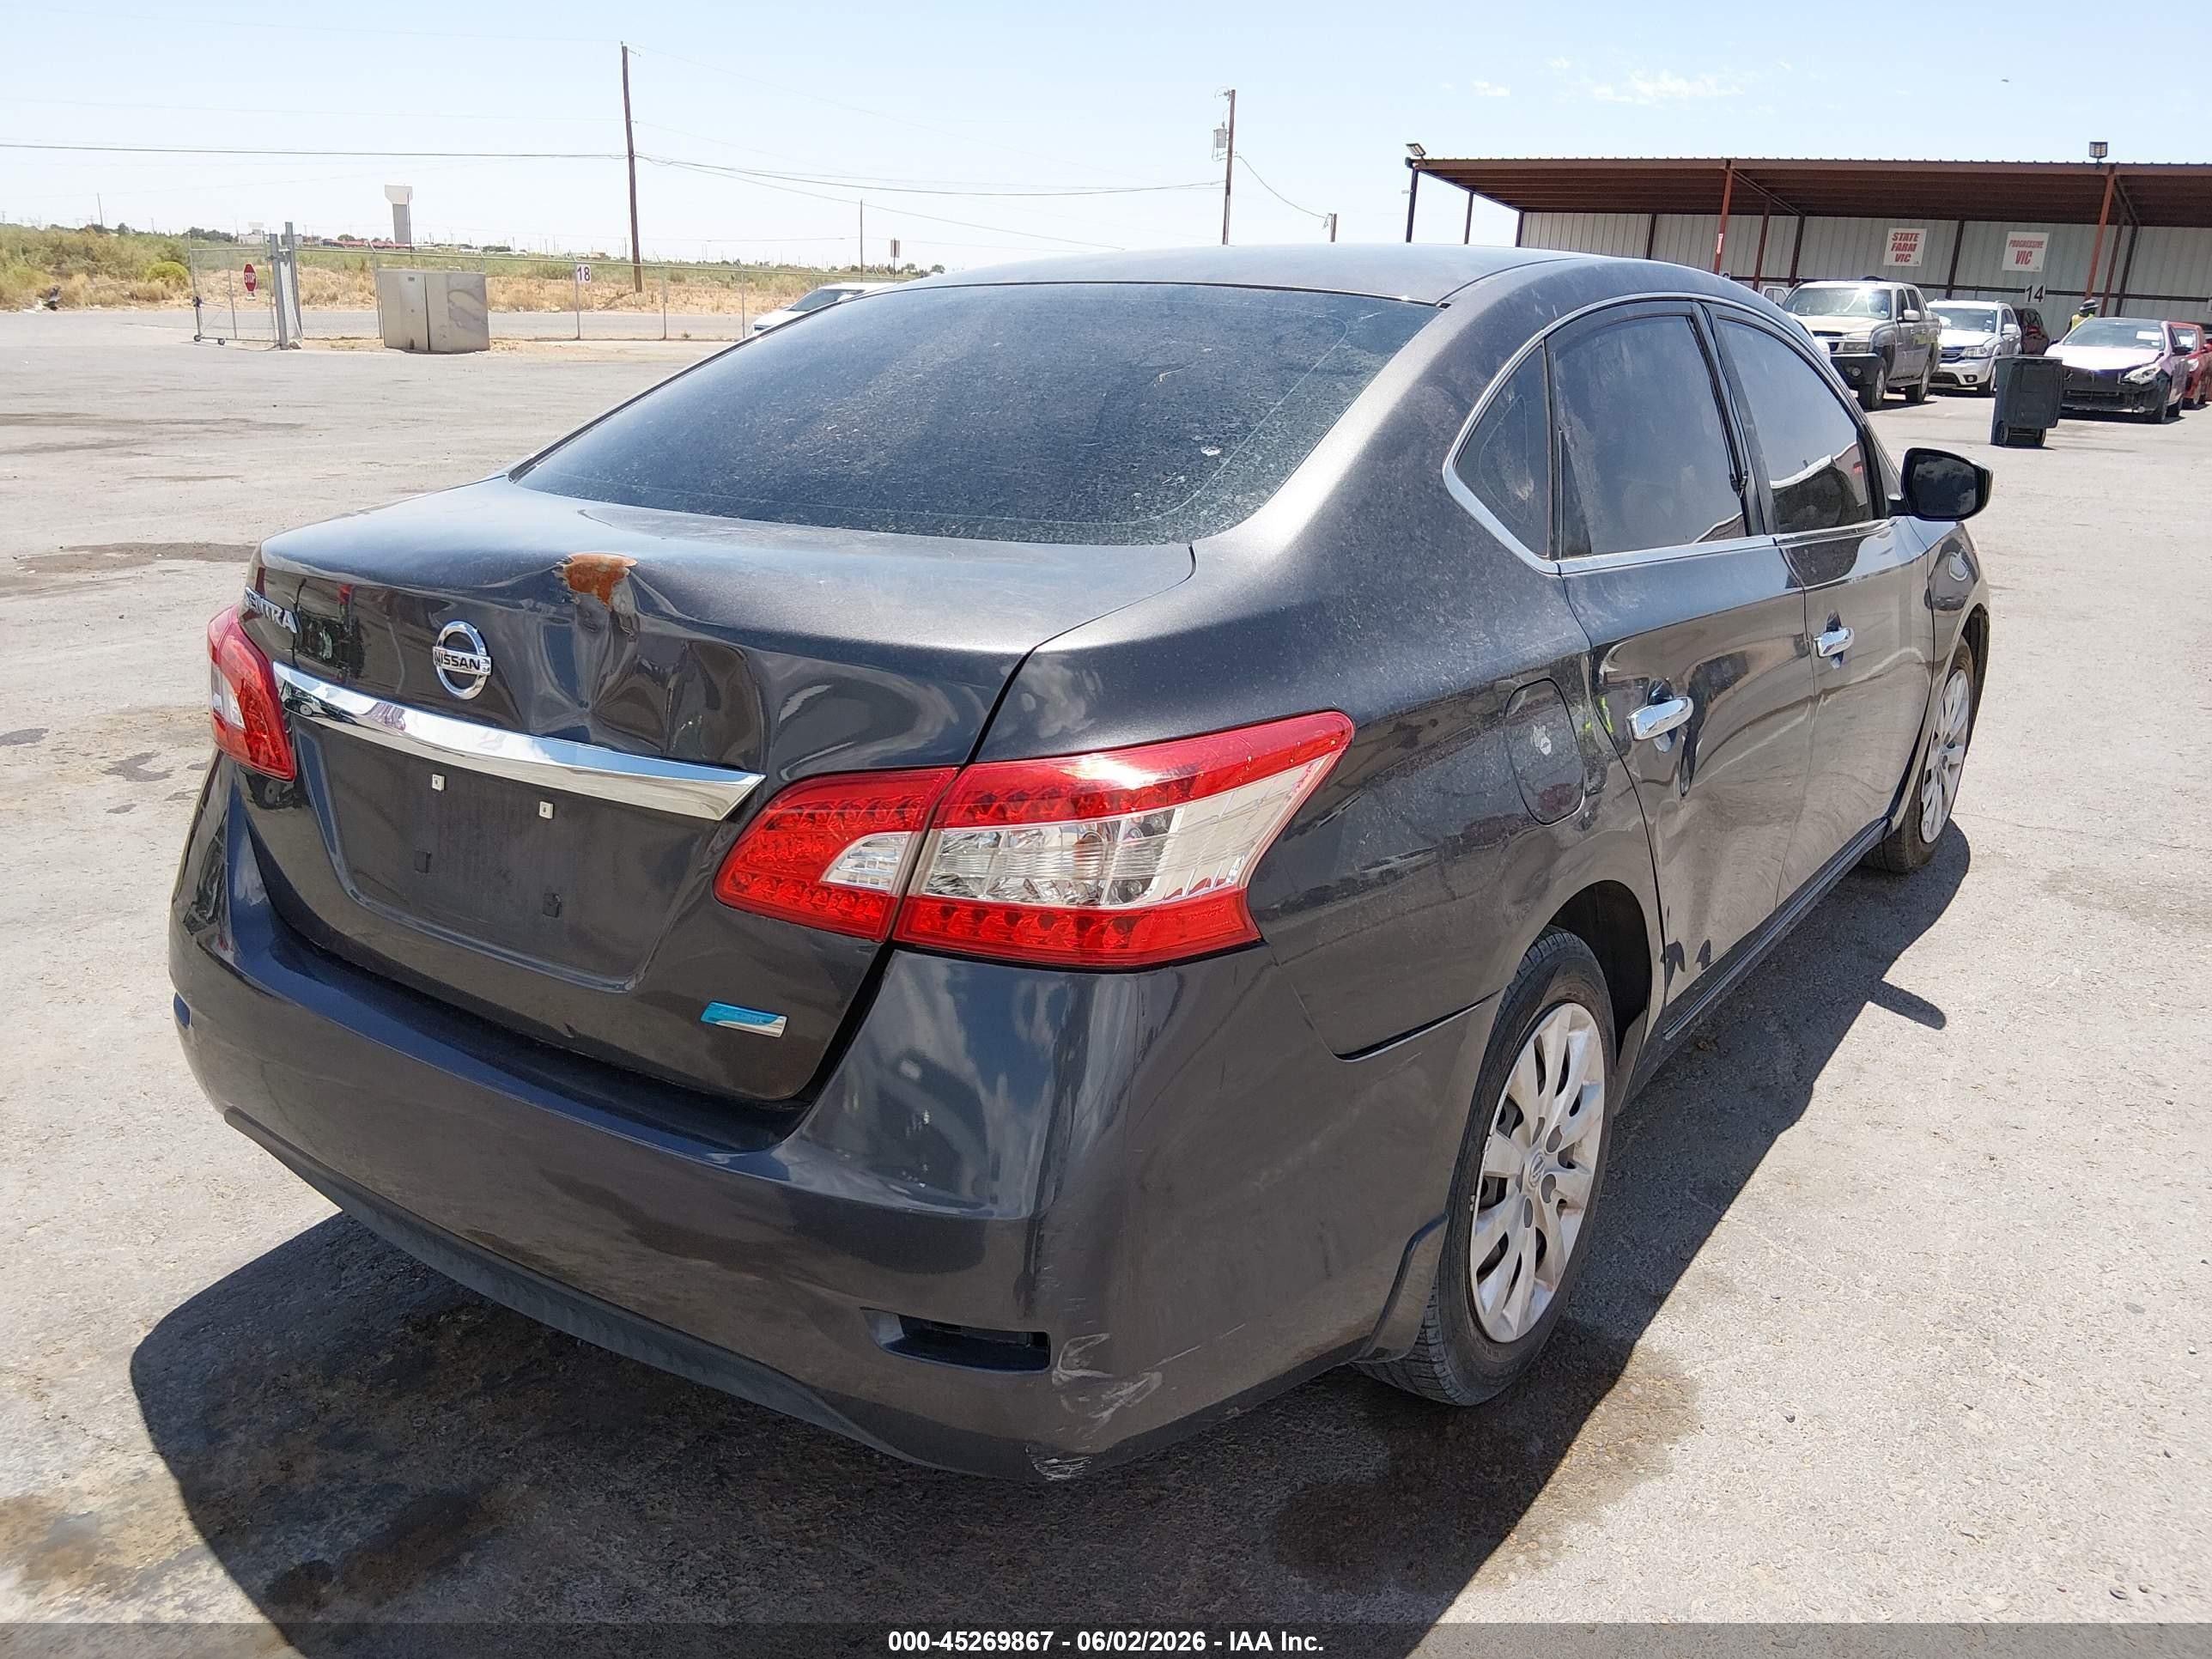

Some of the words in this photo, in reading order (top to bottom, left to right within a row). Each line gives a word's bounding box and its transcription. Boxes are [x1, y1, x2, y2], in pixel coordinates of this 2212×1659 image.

[1892, 232, 1920, 242] STATE
[1891, 242, 1917, 252] FARM
[2008, 240, 2045, 248] PROGRESSIVE
[1894, 253, 1911, 263] VIC
[2015, 250, 2033, 264] VIC
[244, 272, 256, 283] STOP
[577, 266, 590, 282] 18
[2027, 284, 2044, 302] 14
[434, 651, 481, 671] NISSAN
